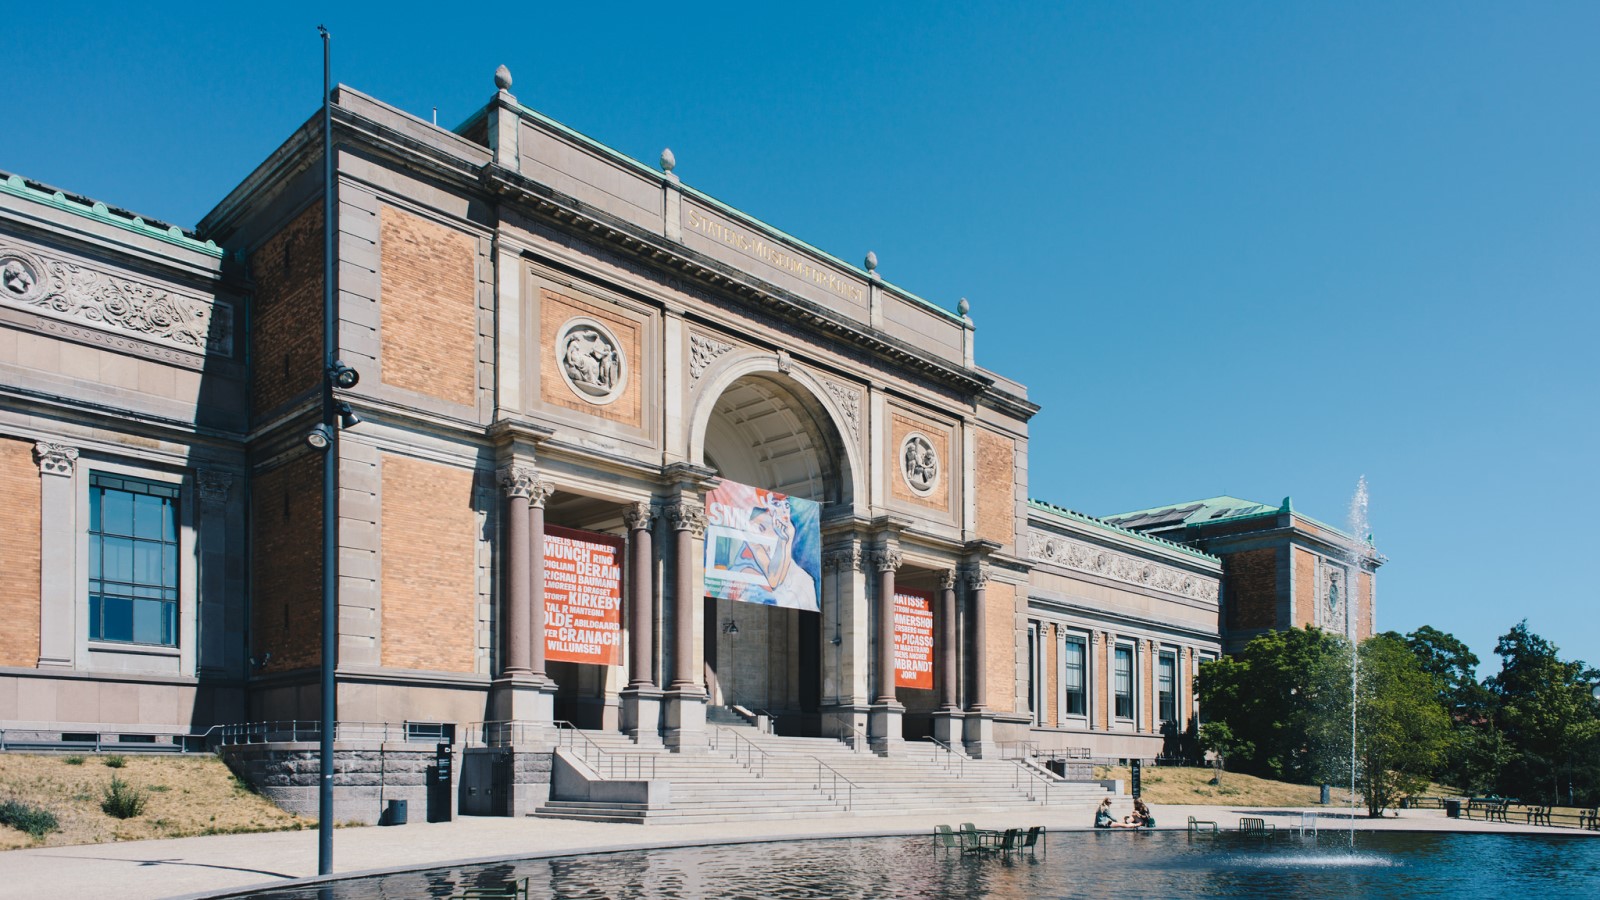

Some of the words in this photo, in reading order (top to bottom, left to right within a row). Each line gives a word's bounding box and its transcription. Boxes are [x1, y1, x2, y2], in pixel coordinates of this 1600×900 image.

[688, 209, 748, 250] STATENS
[752, 238, 803, 277] MUSEUM
[829, 273, 863, 302] KUNST
[544, 535, 571, 546] ORNELIS
[544, 542, 591, 563] MUNCH
[593, 554, 613, 565] RING
[544, 559, 575, 572] DIGLIANI
[576, 561, 620, 580] DERAIN
[544, 570, 576, 583] RICHAU
[578, 575, 618, 589] BAUMANN
[544, 580, 576, 592] LMGREEN
[546, 602, 560, 613] TAL
[569, 591, 622, 611] KIRKEBY
[544, 611, 573, 628] OLDE
[544, 629, 558, 638] YER
[559, 627, 620, 646] CRANACH
[902, 633, 934, 648] PICASSO
[547, 640, 601, 655] WILLUMSEN
[895, 658, 932, 672] MBRANDT
[901, 670, 917, 680] JORN
